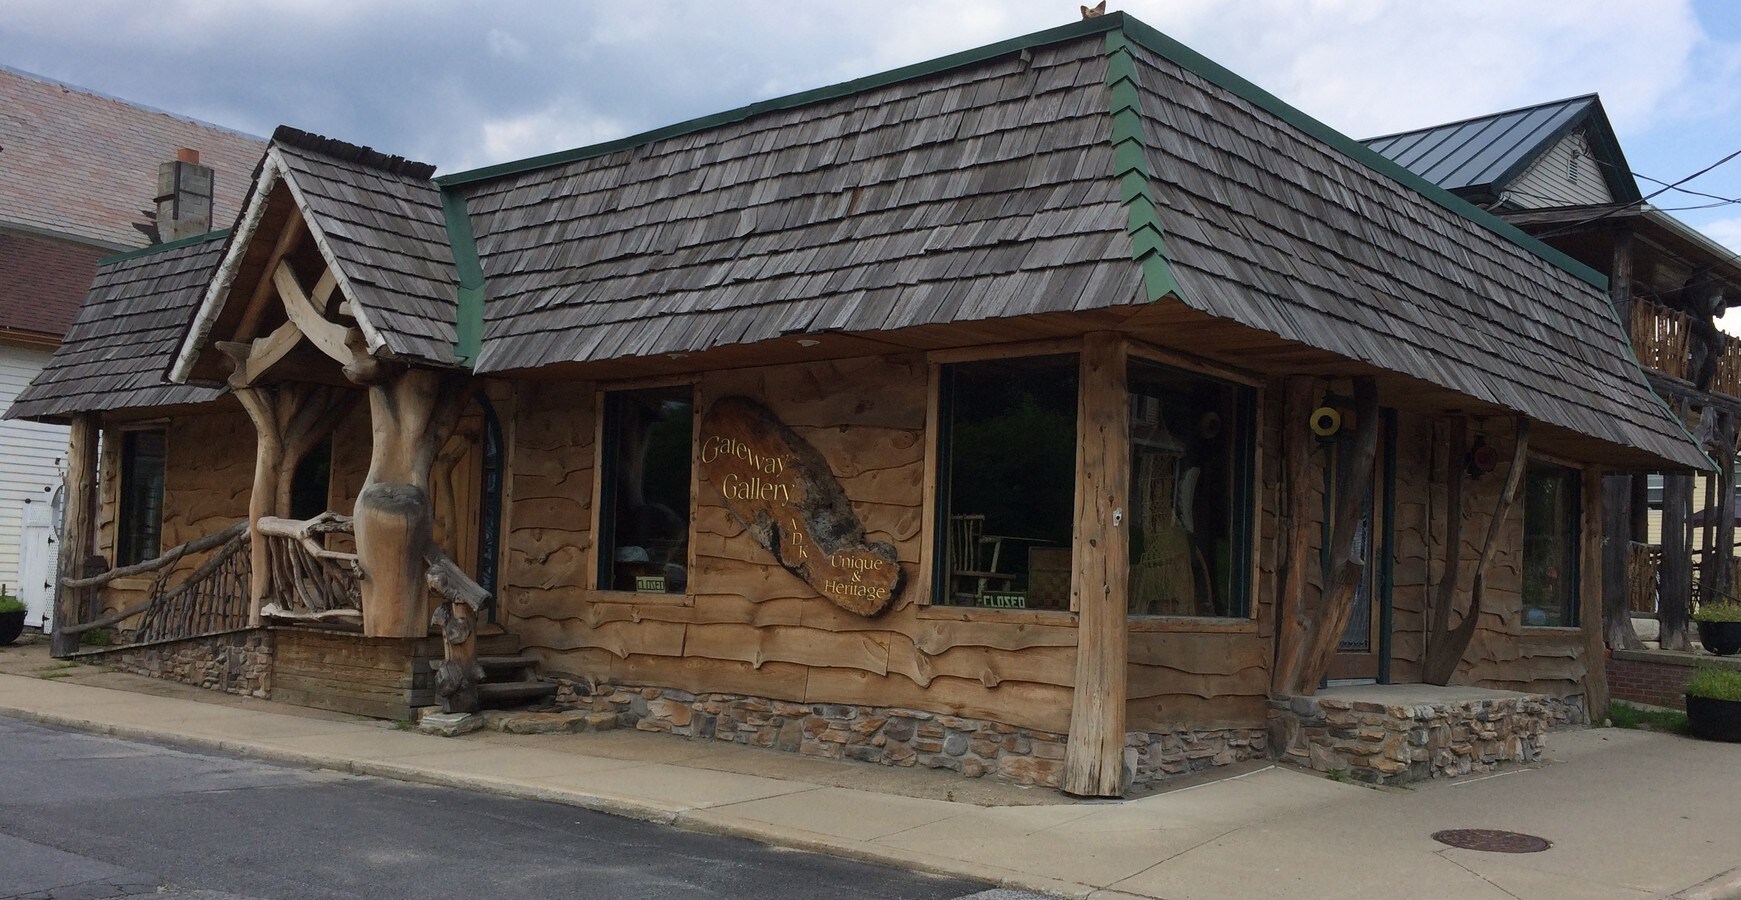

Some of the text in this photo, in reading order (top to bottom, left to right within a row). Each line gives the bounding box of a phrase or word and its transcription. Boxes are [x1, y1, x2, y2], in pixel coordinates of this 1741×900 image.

[722, 473, 795, 507] Gallery
[831, 555, 883, 572] Unique
[851, 570, 861, 583] &
[824, 580, 886, 600] Heritage
[983, 595, 1025, 608] CLOSED
